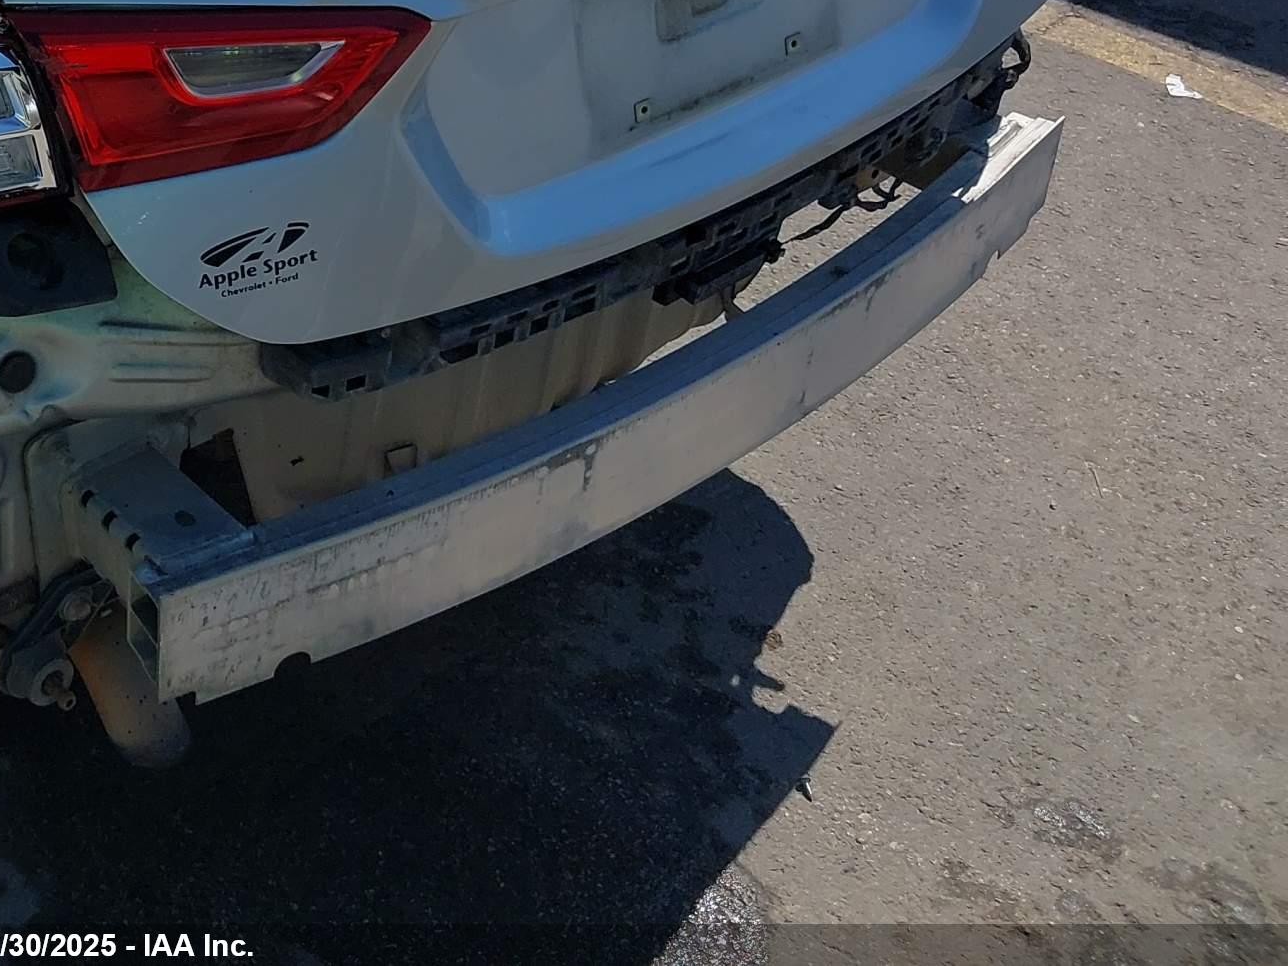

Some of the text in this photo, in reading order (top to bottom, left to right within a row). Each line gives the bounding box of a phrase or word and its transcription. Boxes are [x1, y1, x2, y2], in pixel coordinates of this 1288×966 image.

[199, 250, 318, 290] Apple Sport
[221, 272, 299, 298] Chevrolet Ford
